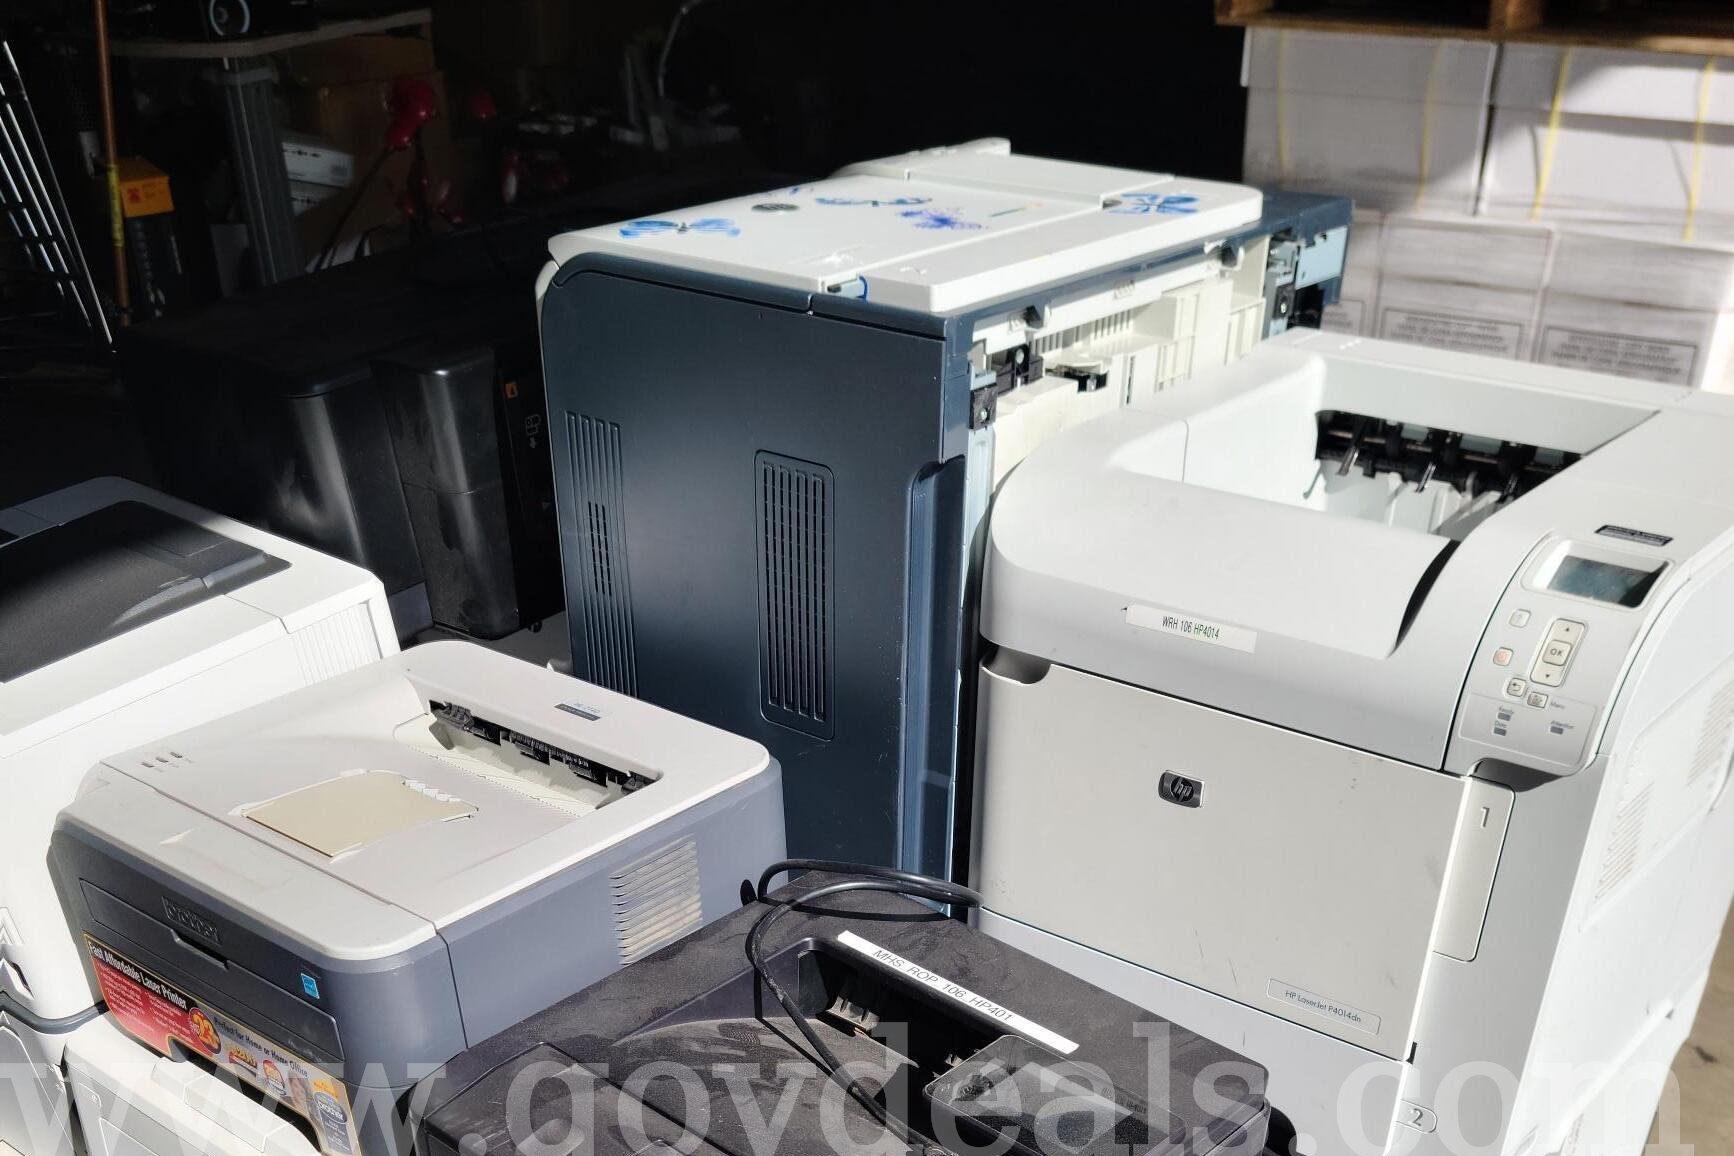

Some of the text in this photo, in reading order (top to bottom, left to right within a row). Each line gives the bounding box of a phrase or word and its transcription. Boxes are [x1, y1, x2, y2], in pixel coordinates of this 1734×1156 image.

[1161, 615, 1220, 640] WRH 106 HP4014
[1549, 647, 1564, 657] OK
[1480, 806, 1491, 829] 1
[104, 950, 141, 983] Affordable
[139, 971, 162, 995] Laser
[160, 983, 188, 1011] Printer
[1285, 990, 1362, 1022] HP LaserJet P4014dn
[245, 1034, 263, 1052] Home
[271, 1049, 289, 1065] Home
[289, 1060, 309, 1079] Office
[1410, 1107, 1424, 1127] 2
